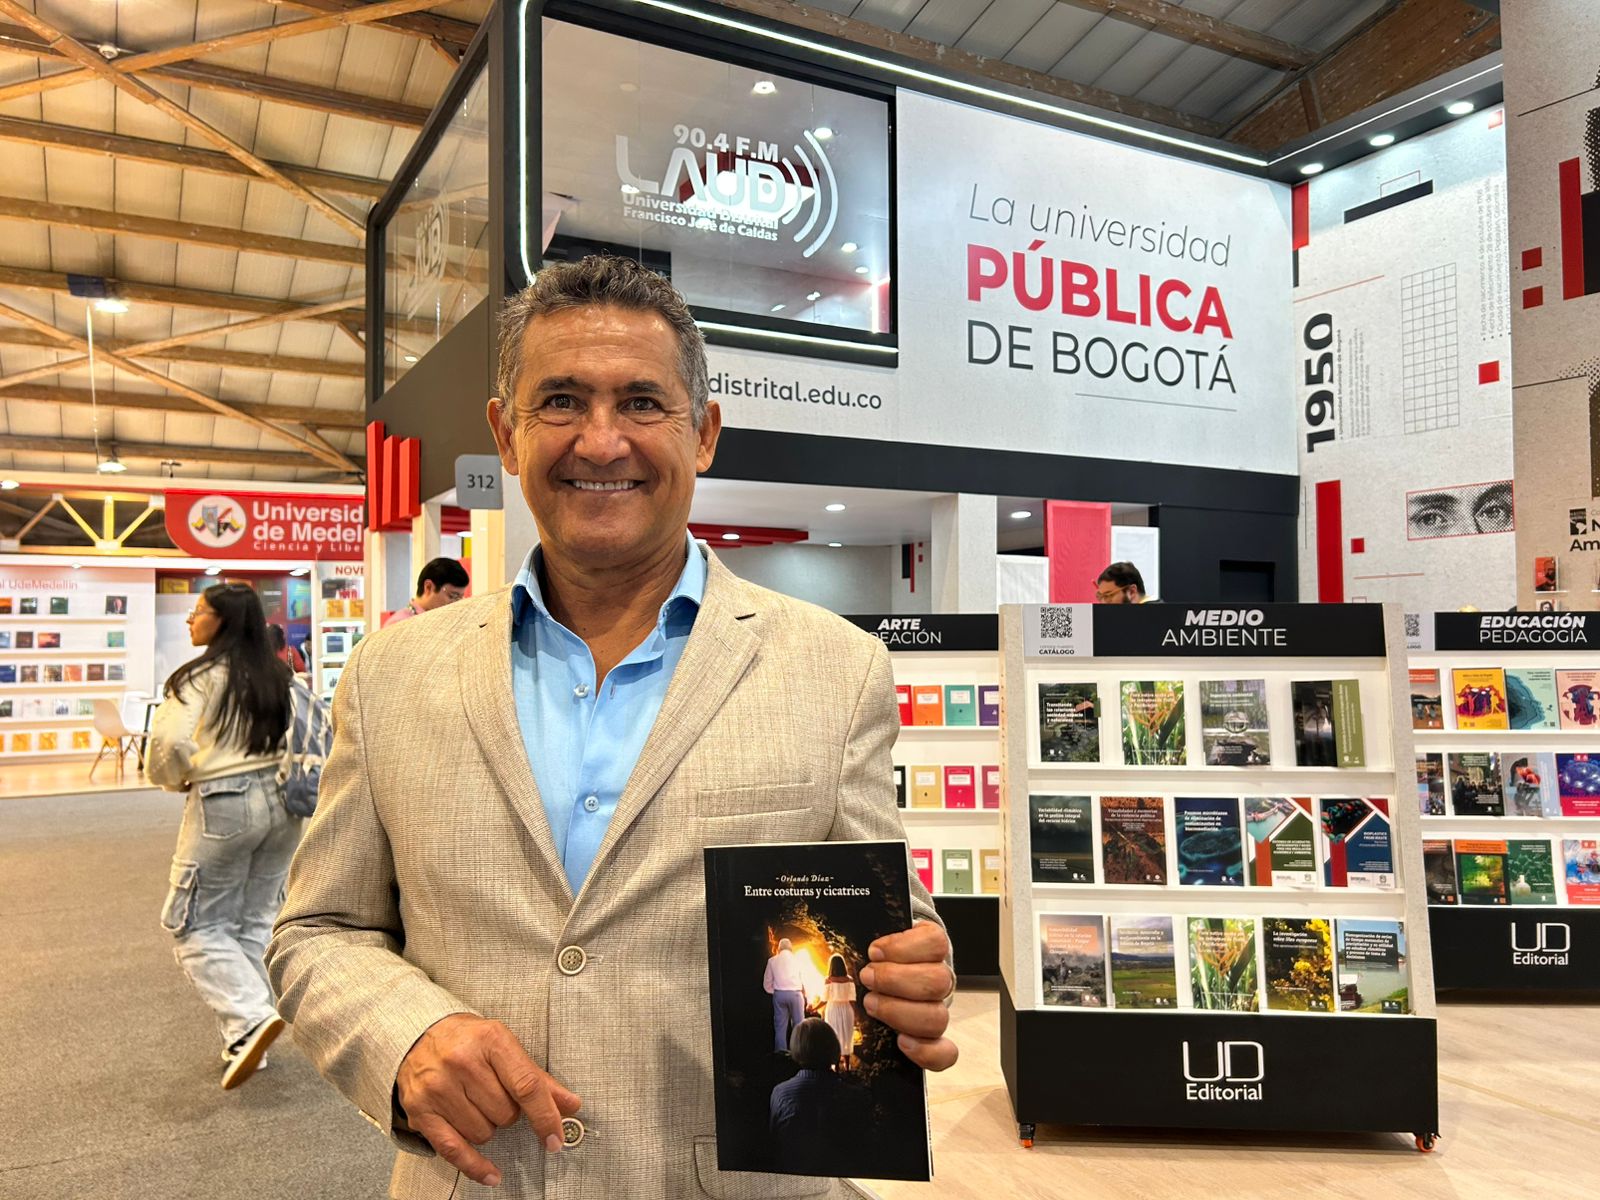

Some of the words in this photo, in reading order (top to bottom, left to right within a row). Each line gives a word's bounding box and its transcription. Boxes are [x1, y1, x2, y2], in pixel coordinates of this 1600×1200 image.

[673, 124, 729, 153] 90.4
[736, 136, 779, 163] F.M
[615, 135, 786, 212] LAUD
[623, 191, 717, 218] Universidad
[624, 207, 686, 226] Francisco
[688, 217, 717, 231] José
[719, 222, 735, 234] de
[737, 225, 778, 241] Caldas
[969, 184, 1015, 226] La
[1030, 204, 1231, 267] universidad
[967, 239, 1233, 339] PÚBLICA
[968, 319, 1033, 370] DE
[1053, 331, 1236, 393] BOGOTÁ
[708, 373, 882, 409] distrital.edu.co
[1304, 313, 1335, 453] 1950
[467, 474, 494, 489] 312
[253, 501, 363, 523] Universid
[253, 521, 285, 541] de
[292, 522, 362, 543] Medel
[253, 542, 309, 551] Ciencia
[878, 619, 921, 630] ARTE
[1185, 609, 1264, 626] MEDIO
[1480, 613, 1586, 629] EDUCACIÓN
[1161, 628, 1287, 646] AMBIENTE
[1479, 627, 1588, 643] PEDAGOGÍA
[744, 885, 773, 896] Entre
[774, 886, 814, 896] costuras
[815, 888, 822, 899] y
[823, 885, 870, 896] cicatrices
[1511, 922, 1570, 952] UD
[1513, 952, 1569, 965] Editorial
[1182, 1041, 1264, 1082] UD
[1186, 1083, 1263, 1100] Editorial
